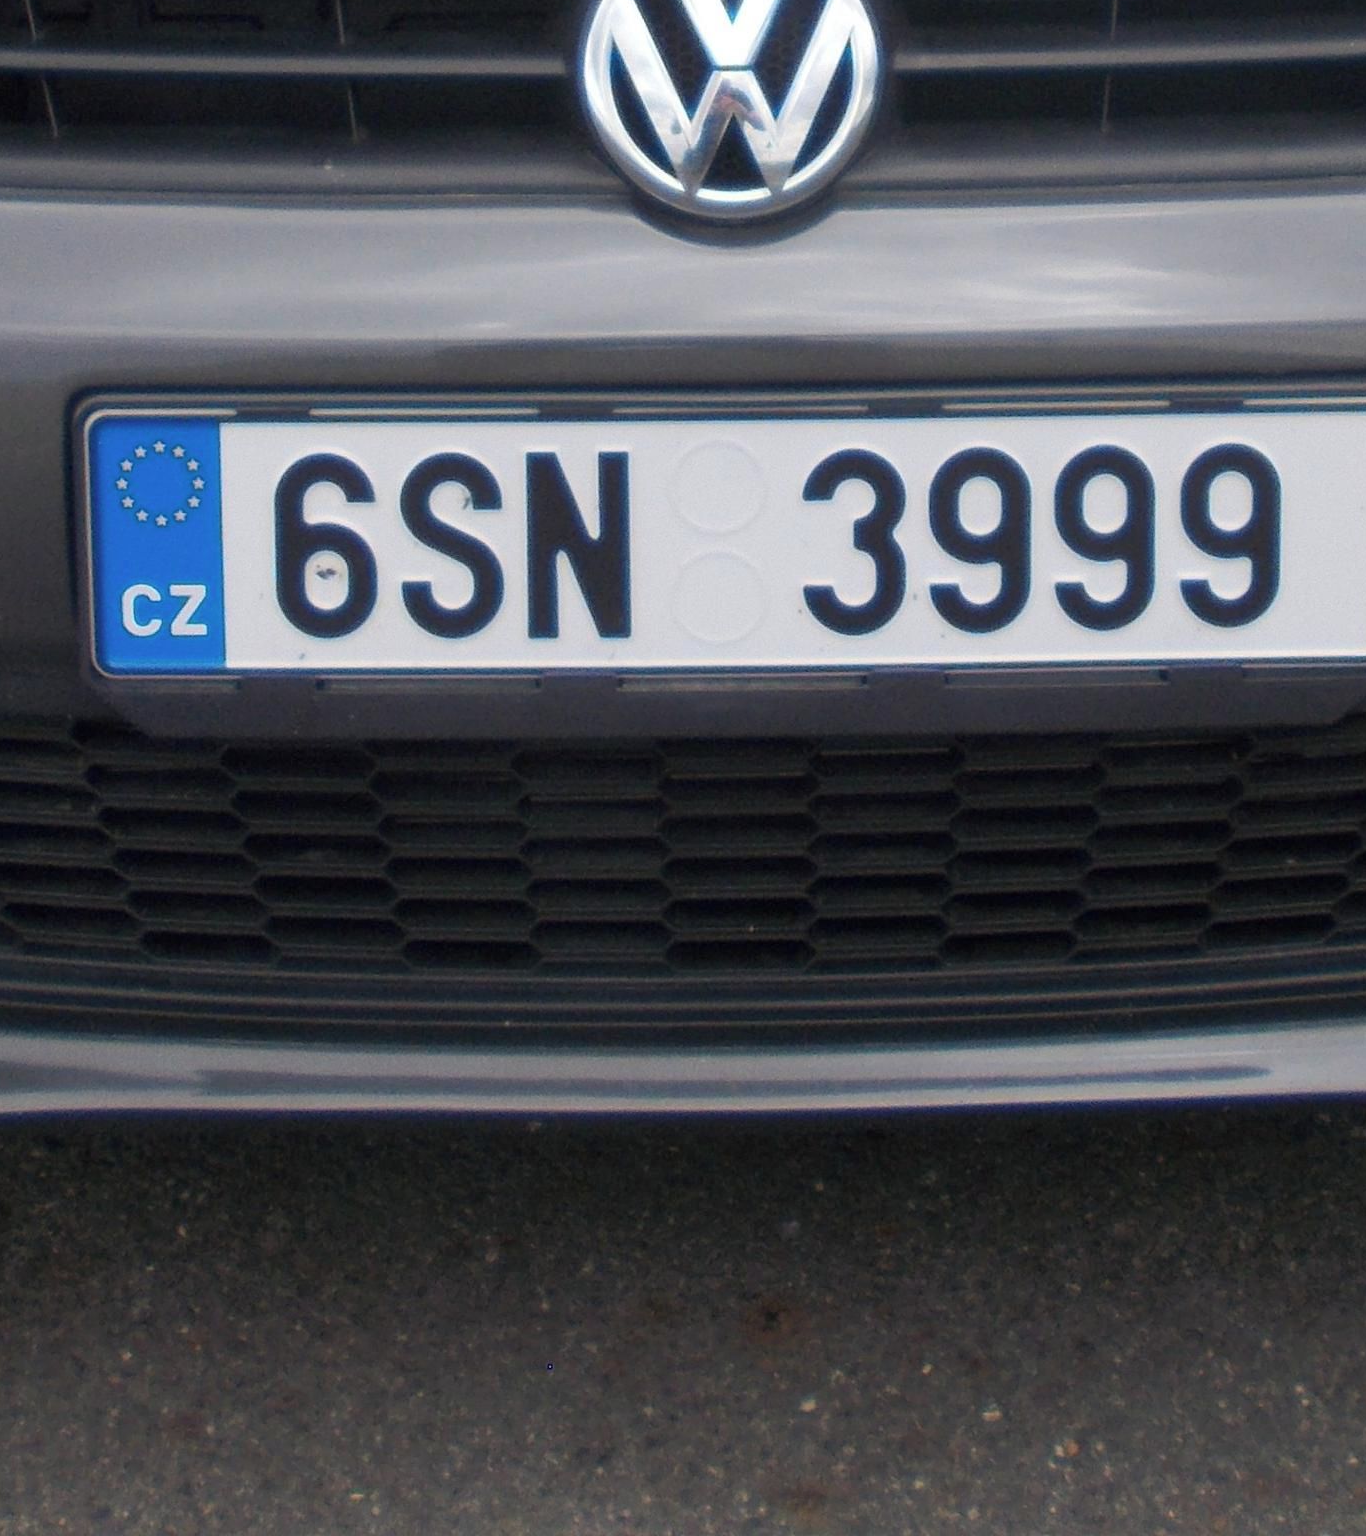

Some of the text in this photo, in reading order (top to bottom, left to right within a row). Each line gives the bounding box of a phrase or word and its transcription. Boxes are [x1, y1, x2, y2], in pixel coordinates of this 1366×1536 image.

[273, 441, 1284, 640] 6SN 3999
[120, 583, 209, 638] CZ
